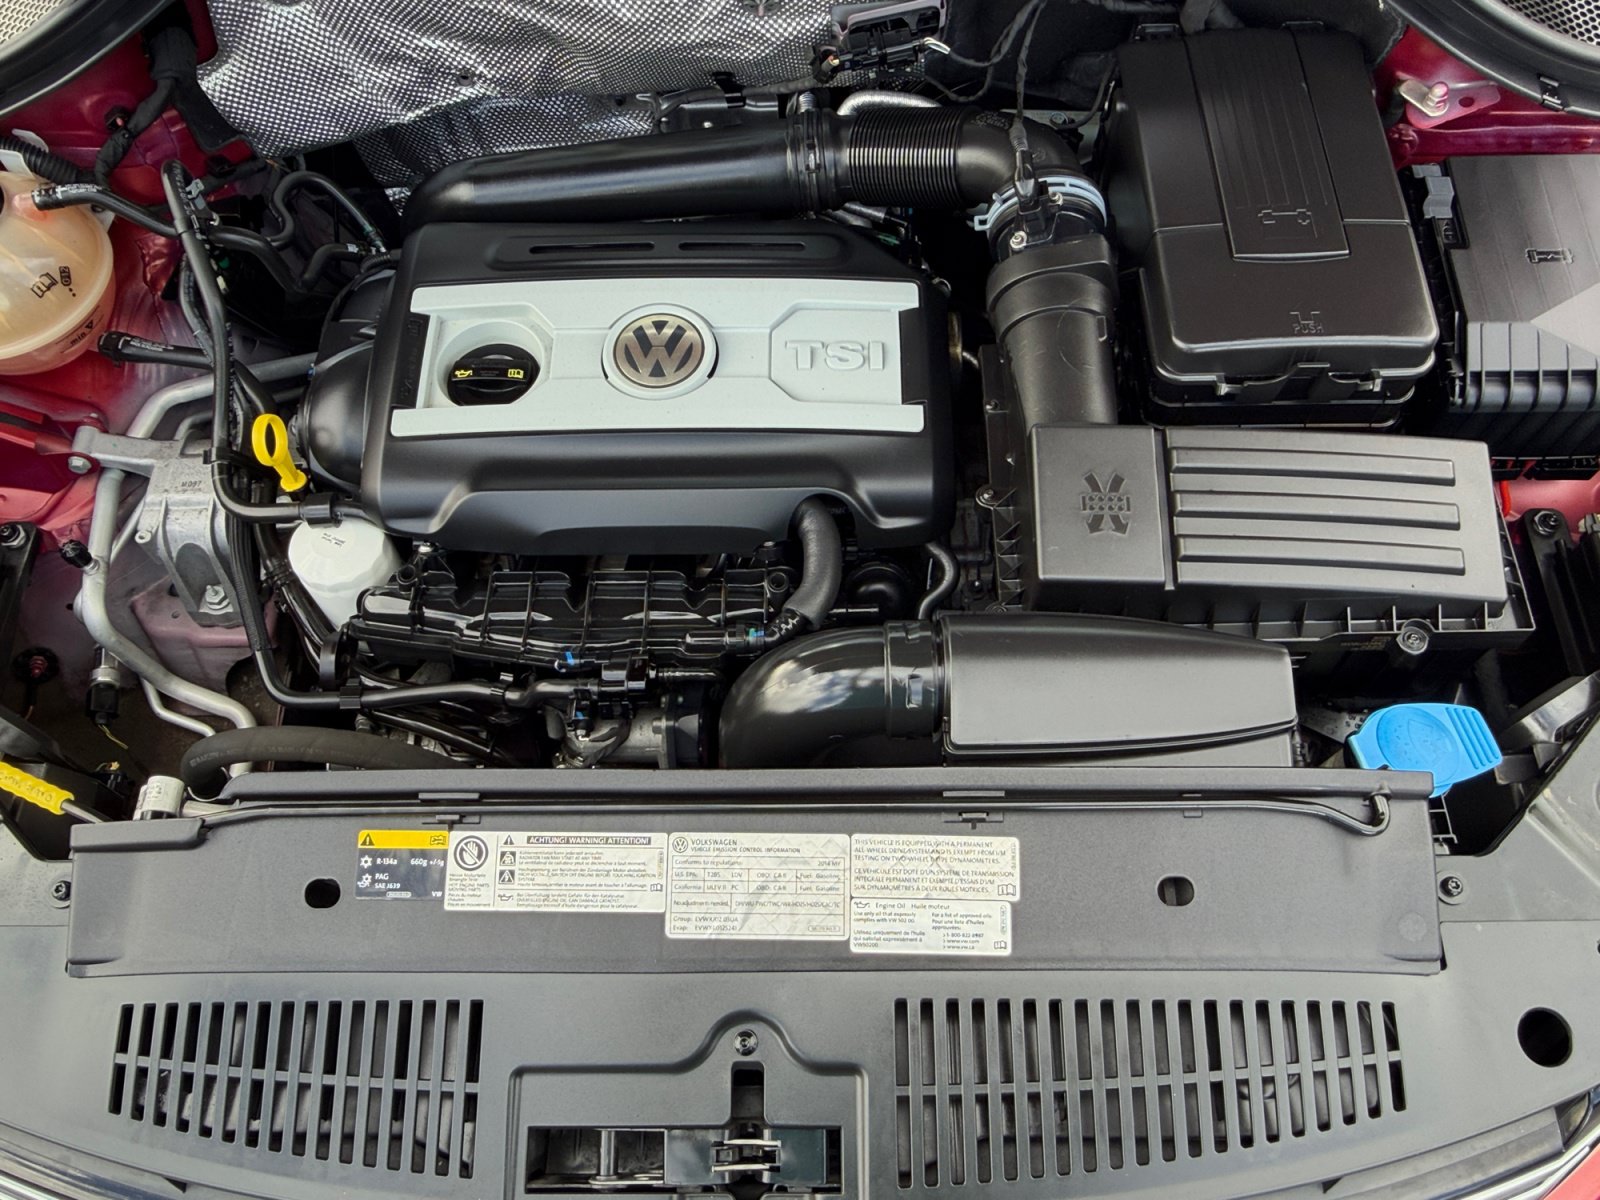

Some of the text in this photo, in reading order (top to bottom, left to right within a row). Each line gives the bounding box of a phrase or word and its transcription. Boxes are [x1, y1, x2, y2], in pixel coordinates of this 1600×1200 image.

[70, 332, 87, 346] min
[785, 341, 886, 371] TSI
[529, 836, 649, 845] ACHTUNG! WARNING! ATTENTION!
[376, 857, 398, 865] R-134a
[410, 858, 427, 867] 660g
